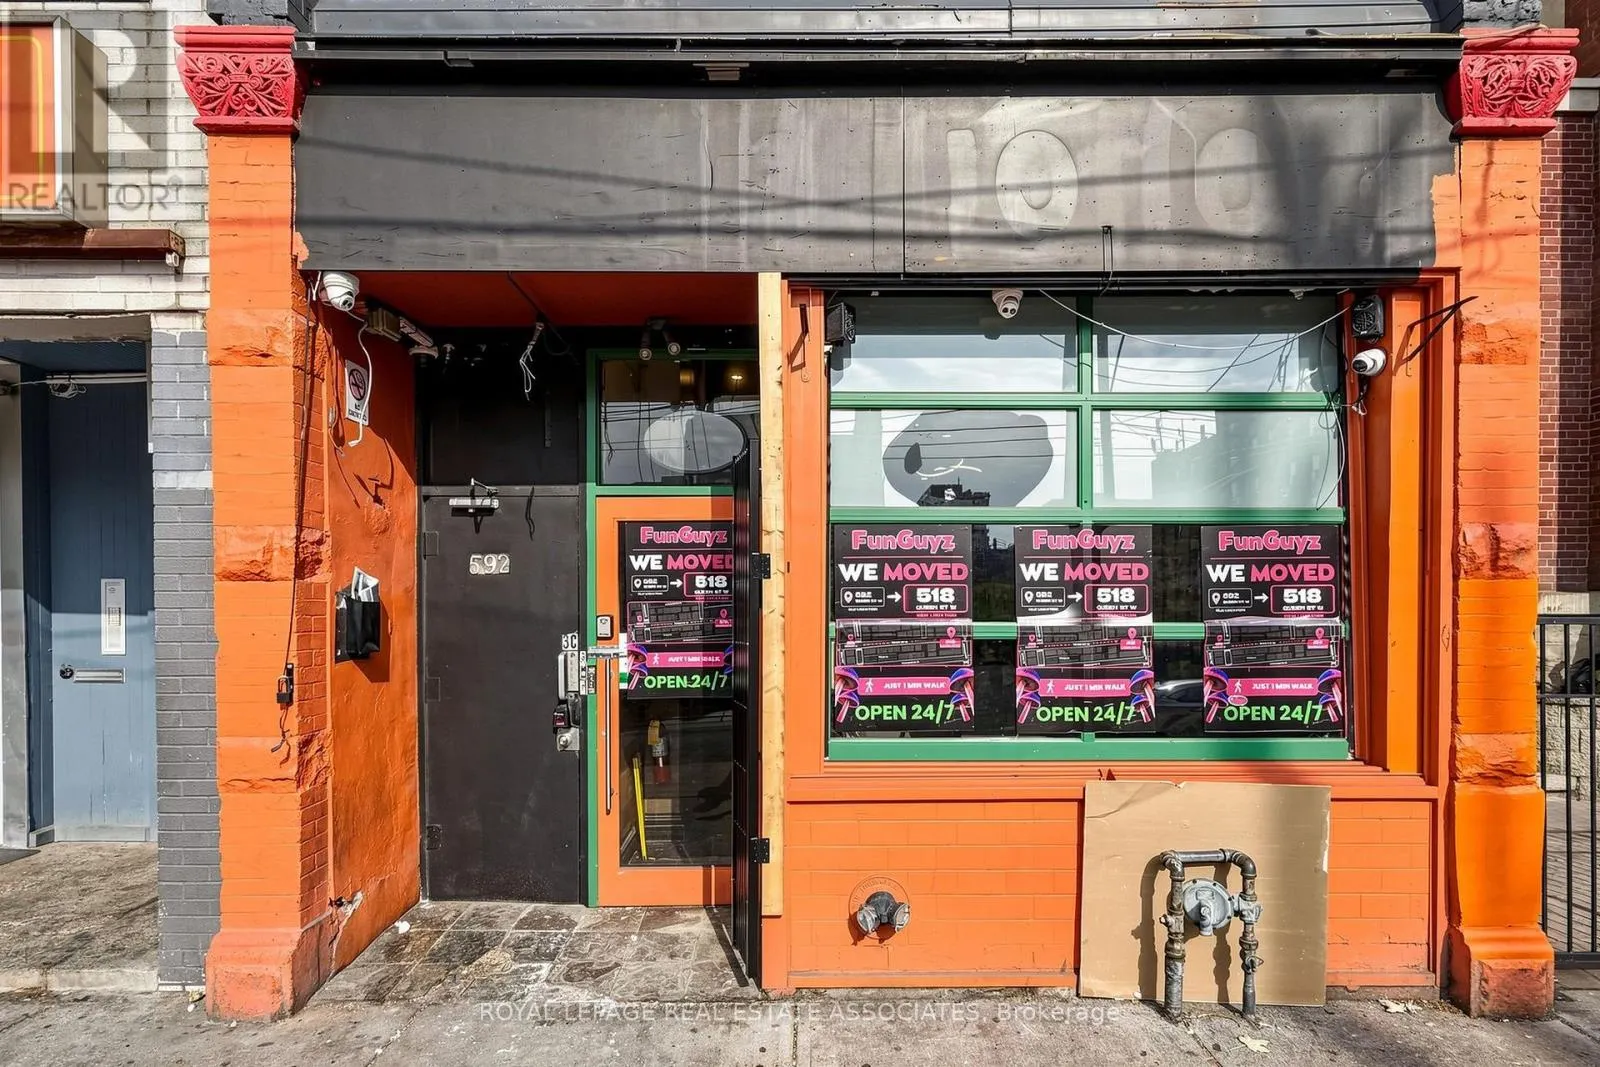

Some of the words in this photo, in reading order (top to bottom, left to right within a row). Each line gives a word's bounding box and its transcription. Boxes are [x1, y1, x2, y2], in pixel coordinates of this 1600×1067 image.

[640, 526, 727, 547] FunGuyz
[851, 529, 956, 554] FunGuyz
[1032, 529, 1135, 554] FunGuyz
[1218, 530, 1321, 554] FunGuyz
[469, 554, 510, 575] 592
[629, 554, 663, 571] WE
[838, 563, 879, 582] WE
[884, 562, 969, 581] MOVED
[1019, 563, 1059, 582] WE
[1064, 562, 1149, 581] MOVED
[695, 575, 727, 588] 518
[1206, 564, 1245, 583] WE
[1251, 564, 1335, 582] MOVED
[916, 587, 955, 604] 518
[1096, 587, 1135, 604] 518
[1283, 588, 1322, 604] 518
[644, 674, 687, 689] OPEN
[688, 671, 728, 690] 24/7
[855, 705, 907, 721] OPEN
[911, 700, 955, 724] 24/7
[1036, 706, 1088, 722] OPEN
[1093, 702, 1135, 725] 24/7
[1223, 705, 1276, 721] OPEN
[1279, 701, 1323, 724] 24/7
